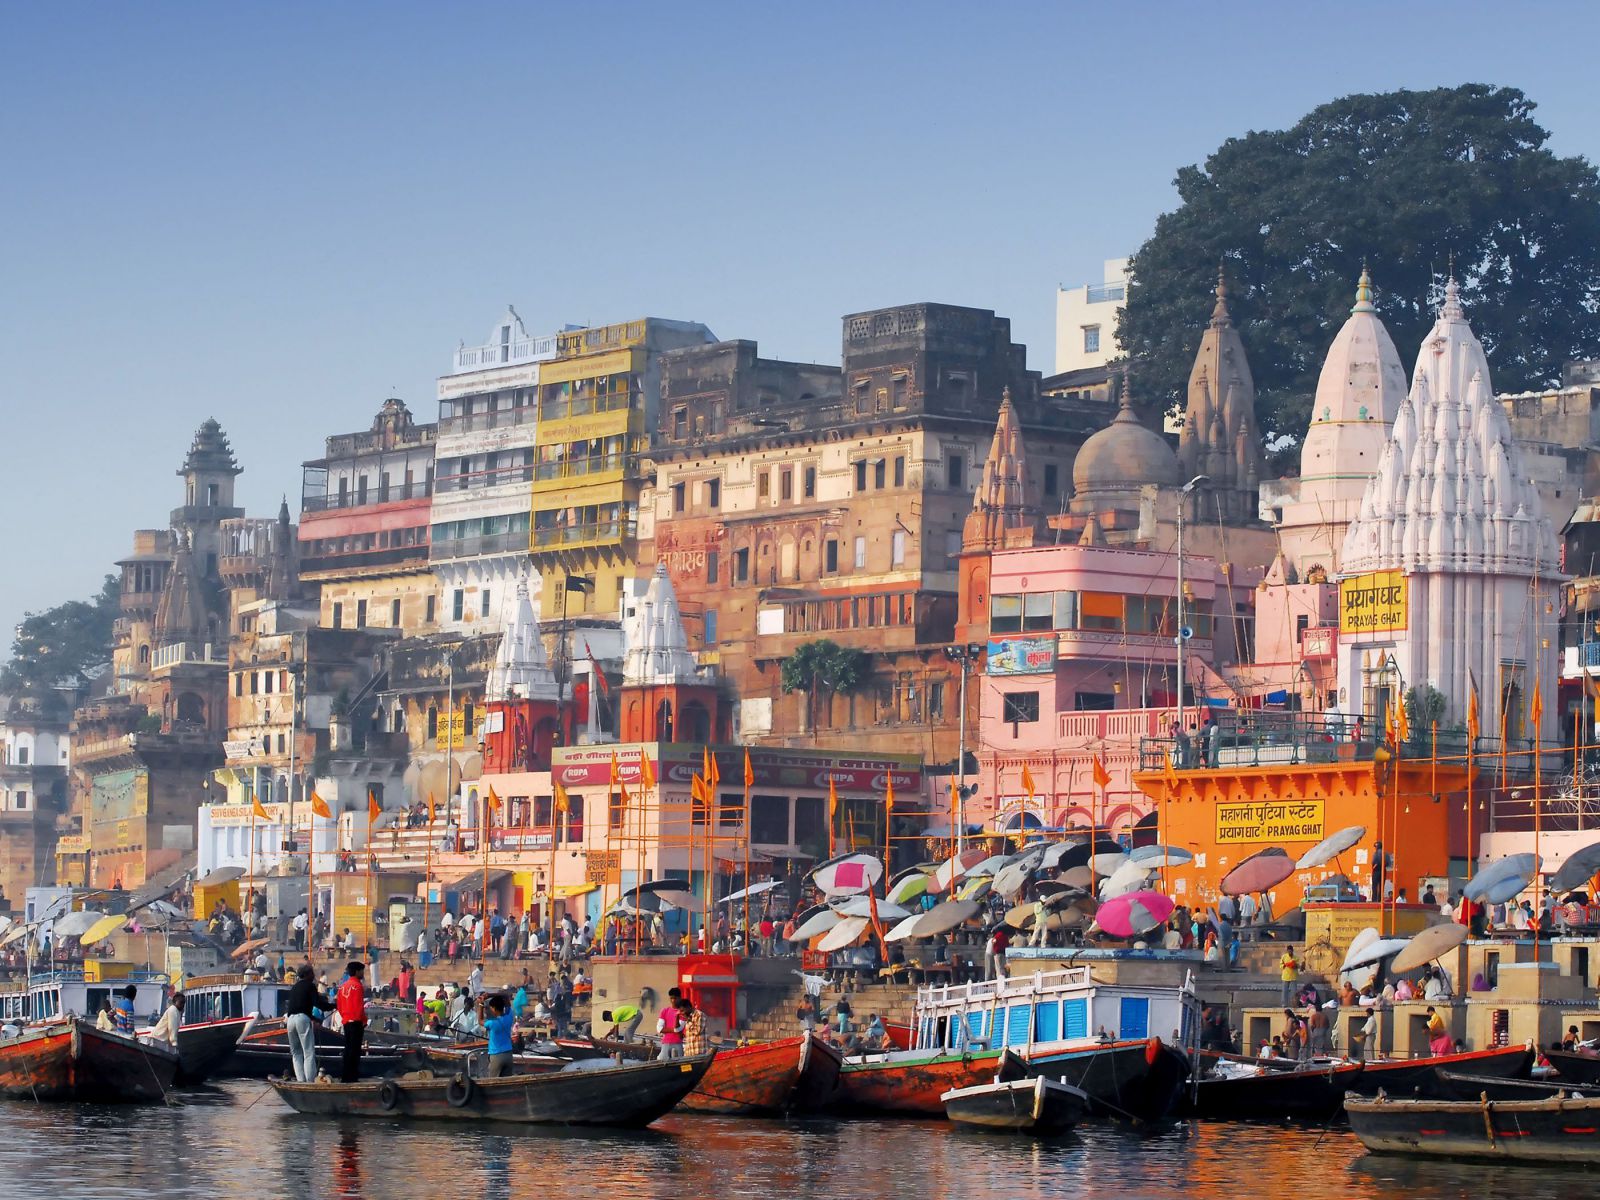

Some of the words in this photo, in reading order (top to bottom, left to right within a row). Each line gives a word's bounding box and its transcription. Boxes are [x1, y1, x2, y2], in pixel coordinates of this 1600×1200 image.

[1345, 588, 1380, 612] प्रयाग
[1381, 586, 1402, 605] घाट
[1348, 614, 1378, 627] PRAYAG
[1381, 612, 1402, 625] GHAT
[568, 768, 588, 777] RUPA
[620, 766, 641, 775] RUPA
[679, 766, 703, 775] RUP
[1219, 827, 1244, 839] प्रयाग
[1245, 826, 1260, 837] घाट
[1267, 824, 1300, 836] PRAYAG
[1301, 823, 1322, 835] GHAT
